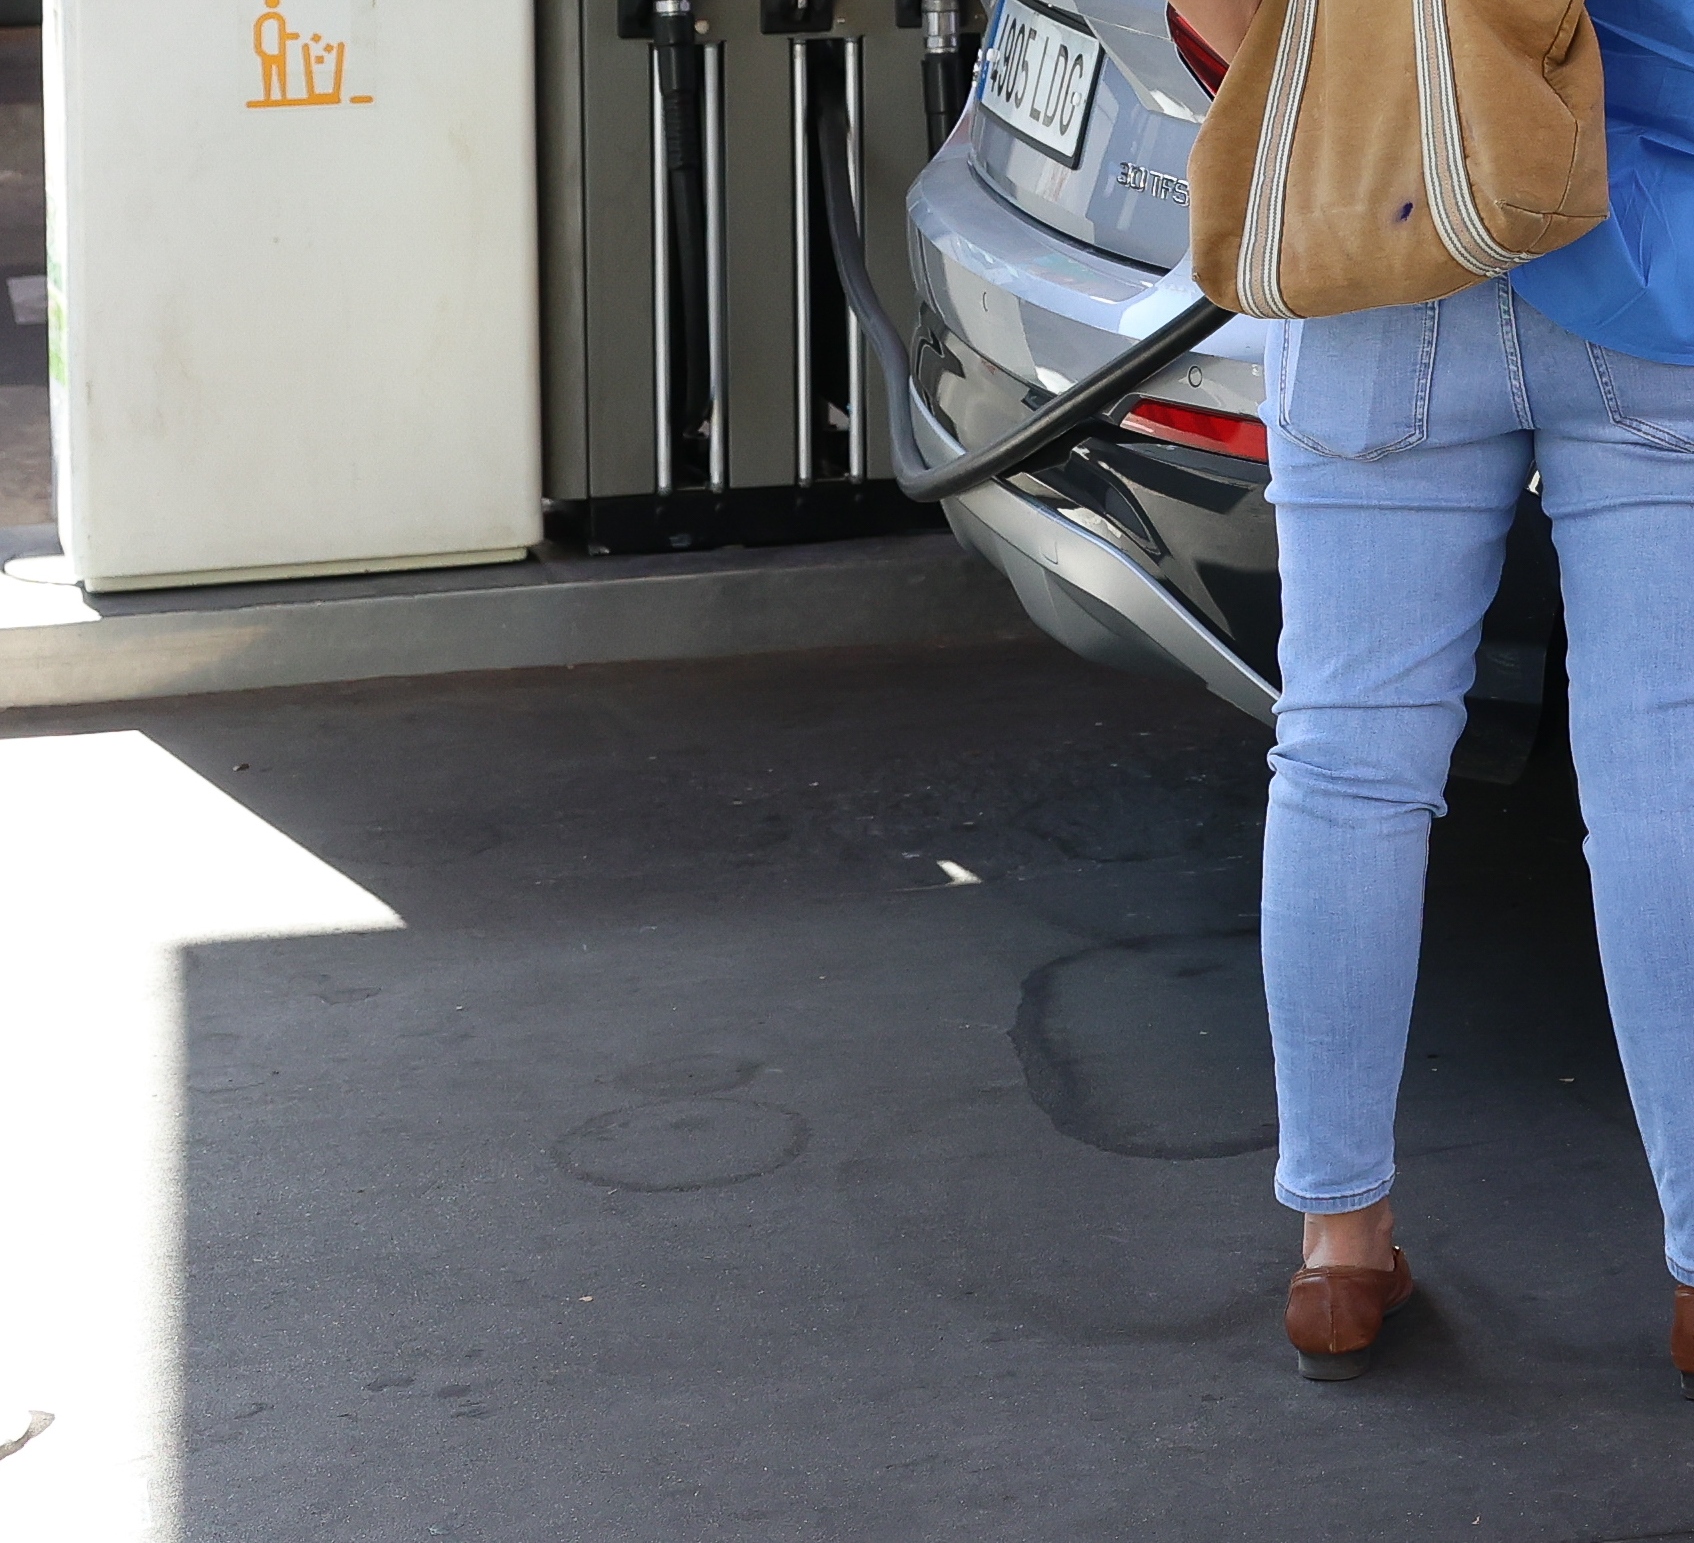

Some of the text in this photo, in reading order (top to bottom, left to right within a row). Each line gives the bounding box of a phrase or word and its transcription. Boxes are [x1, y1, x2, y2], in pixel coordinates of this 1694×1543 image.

[1029, 36, 1084, 137] LDG
[1116, 161, 1191, 208] 30 TFS
